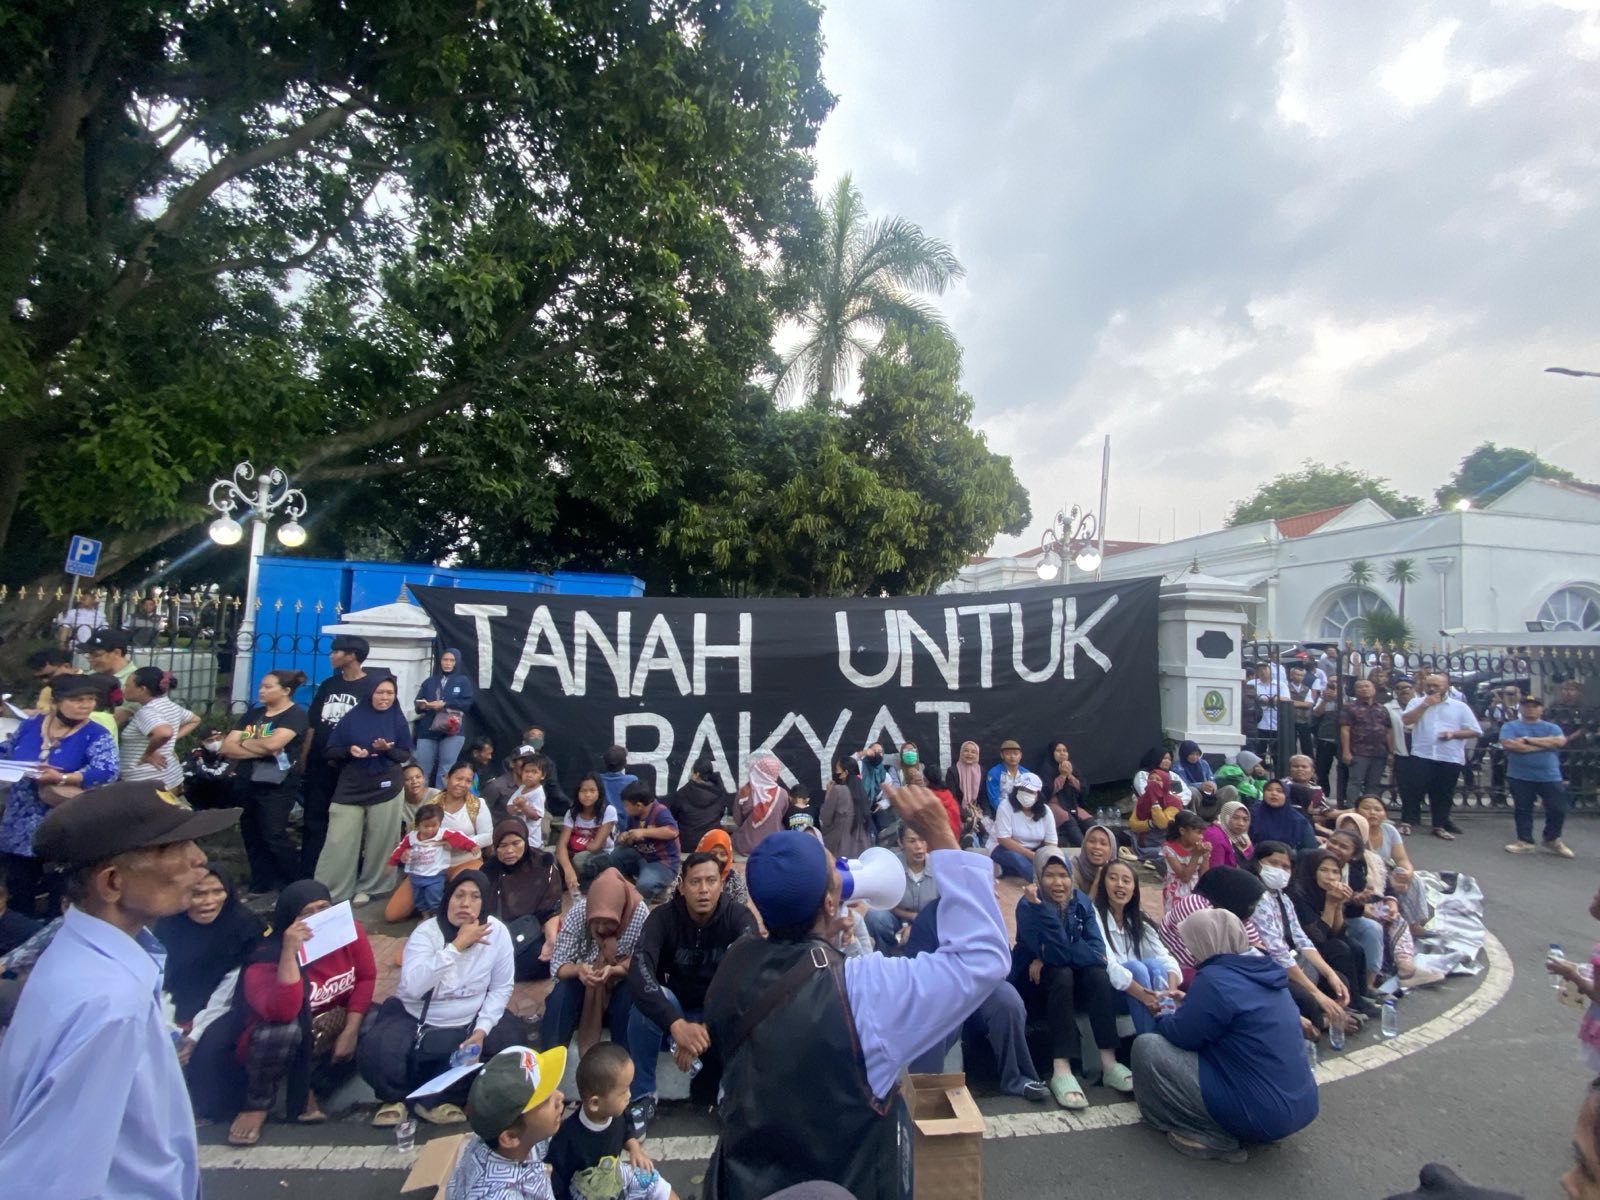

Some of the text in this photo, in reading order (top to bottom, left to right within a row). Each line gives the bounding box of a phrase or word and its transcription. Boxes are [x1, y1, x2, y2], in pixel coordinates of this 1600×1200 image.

[75, 539, 94, 561] P
[454, 594, 1119, 697] TANAH UNTUK
[614, 701, 970, 796] RAKYAT
